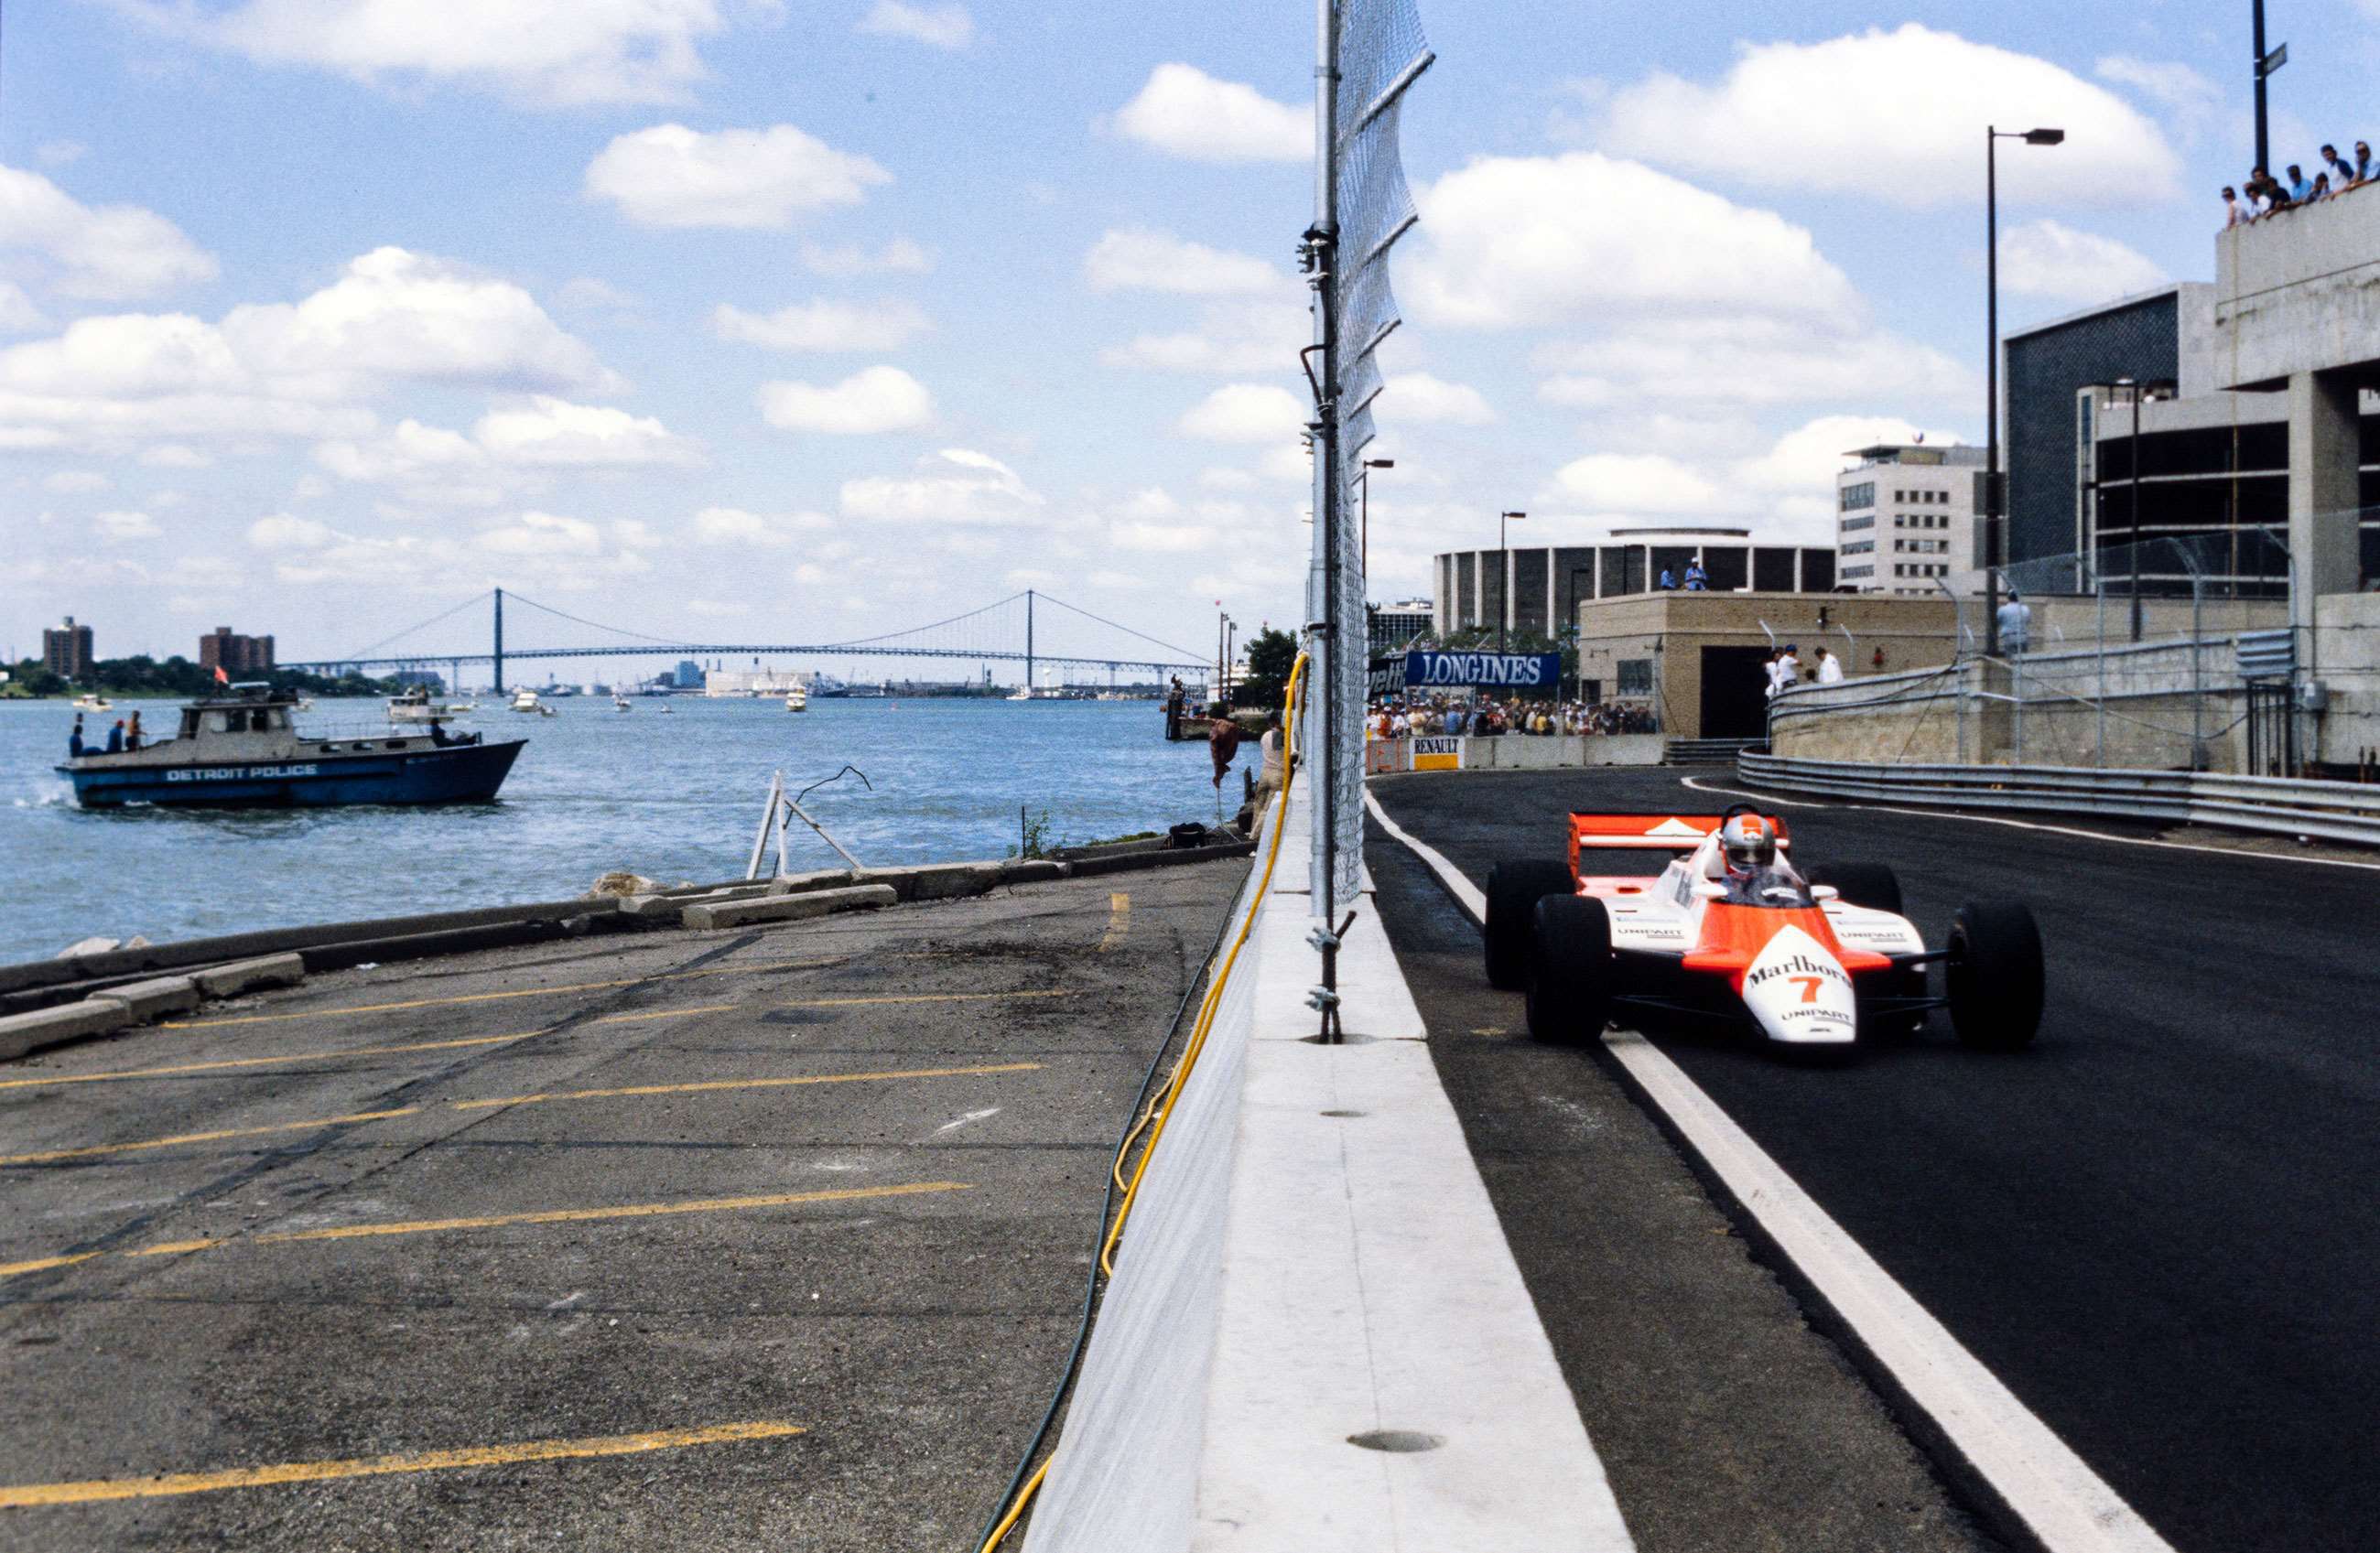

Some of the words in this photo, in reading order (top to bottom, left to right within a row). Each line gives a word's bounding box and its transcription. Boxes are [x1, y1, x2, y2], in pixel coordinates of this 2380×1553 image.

[1423, 654, 1542, 685] LONGINES
[1414, 739, 1459, 754] RENAULT
[167, 768, 246, 782] DETROIT
[250, 764, 318, 777] POLICE
[1788, 976, 1823, 1003] 7
[1781, 1008, 1850, 1021] UNIPART
